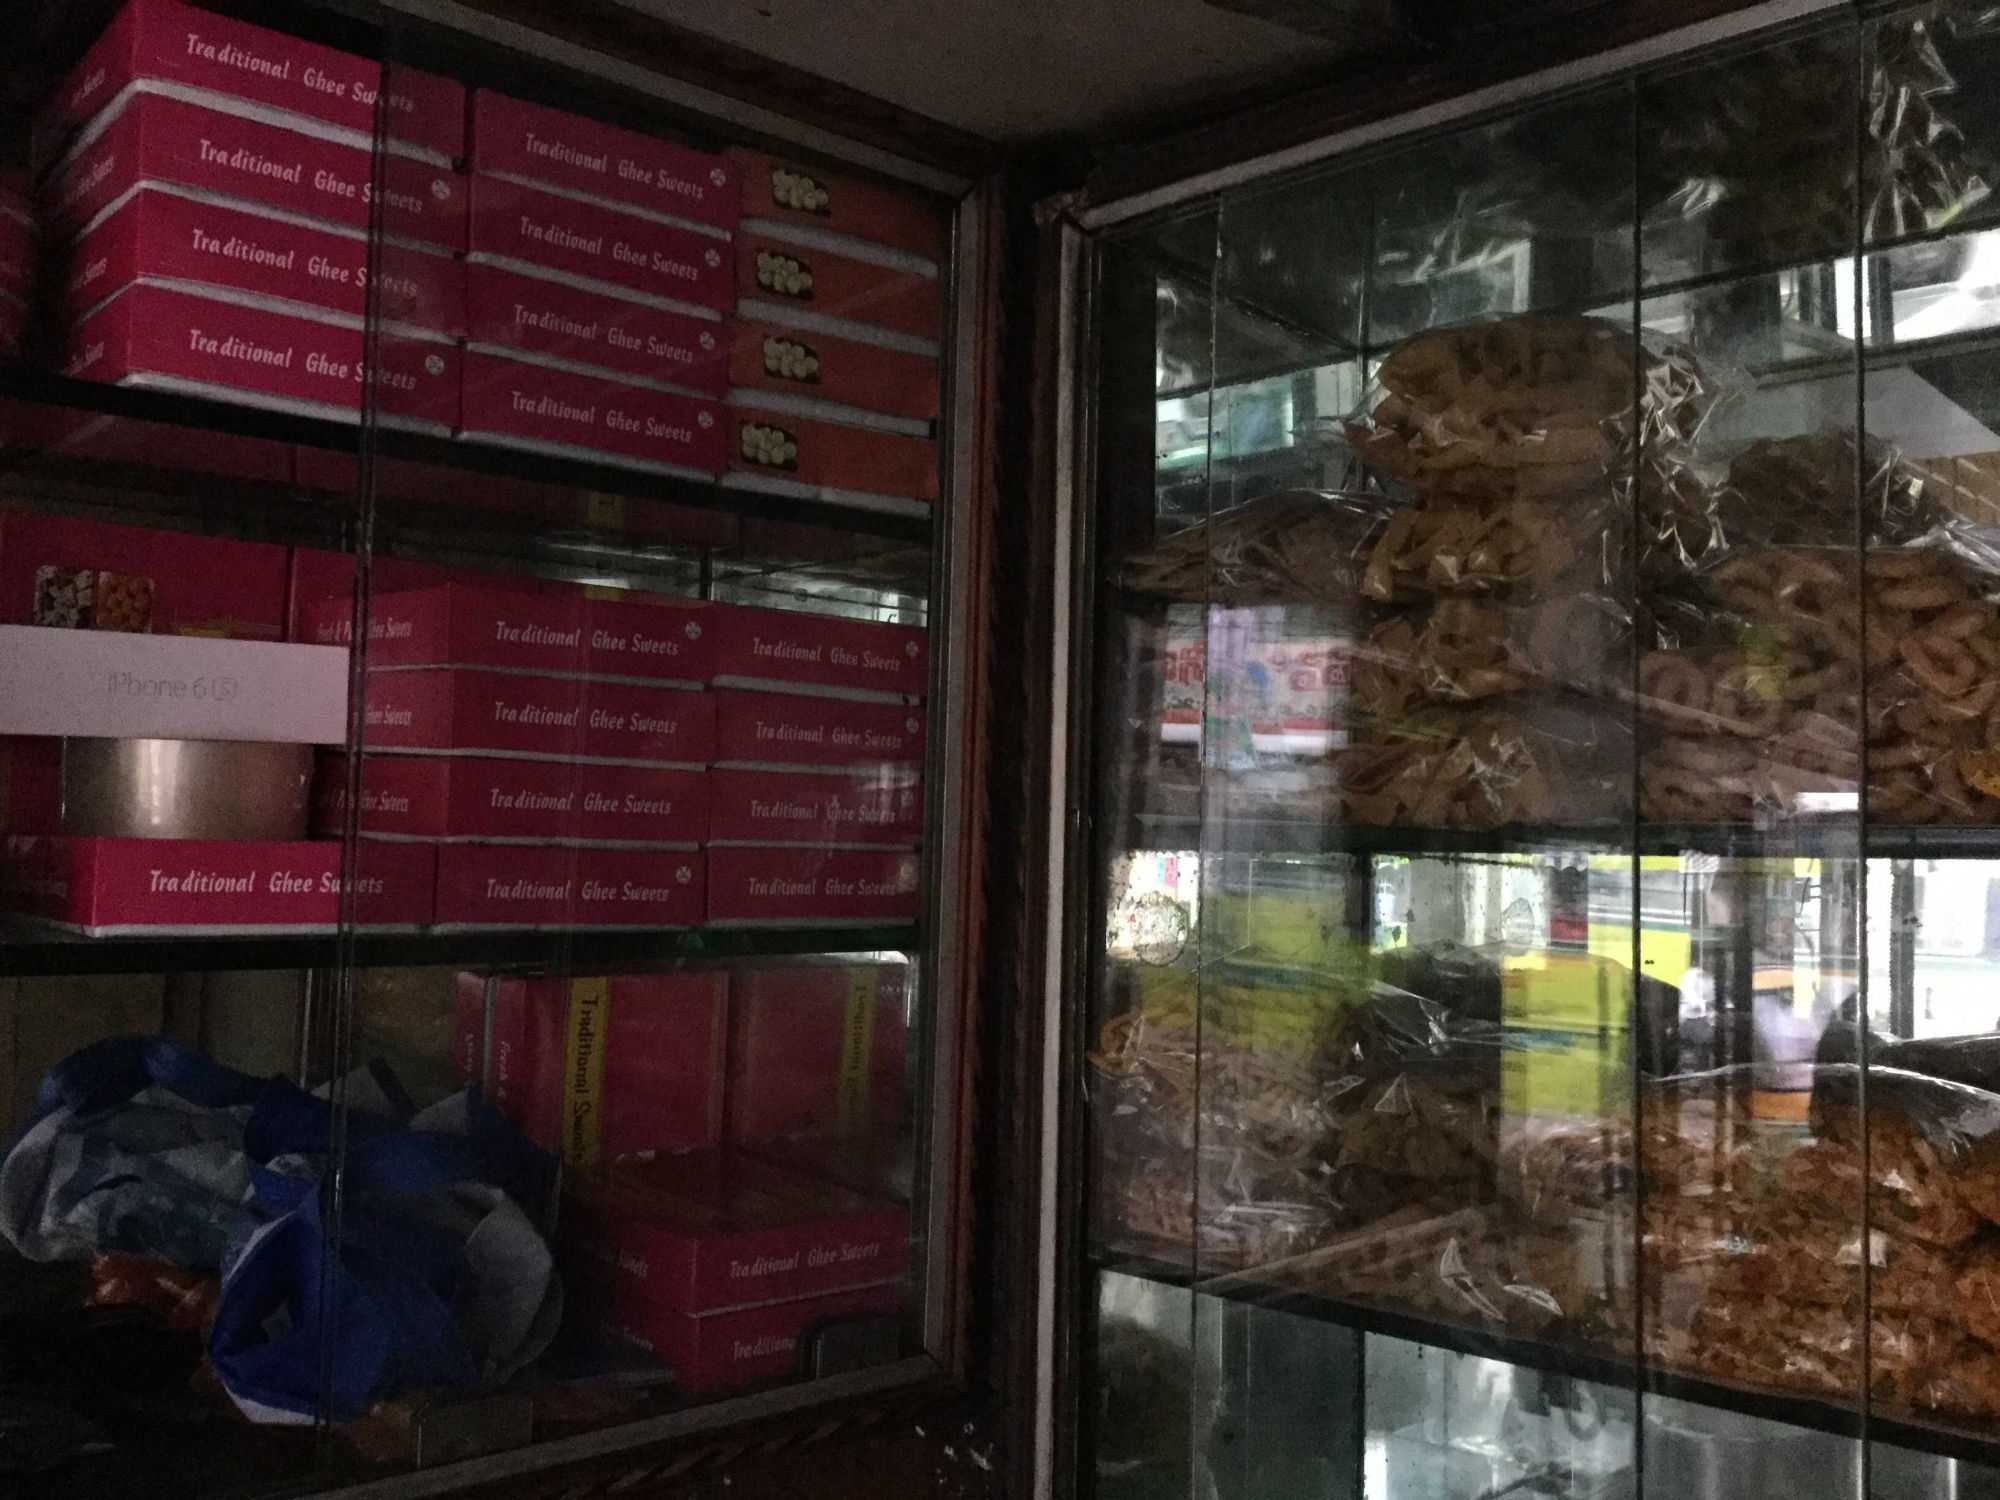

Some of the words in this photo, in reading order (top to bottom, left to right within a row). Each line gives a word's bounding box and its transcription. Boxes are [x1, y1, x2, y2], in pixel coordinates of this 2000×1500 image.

[186, 33, 290, 80] Traditional
[303, 67, 346, 98] Ghee
[200, 139, 302, 184] Traditional
[314, 169, 356, 199] Ghee
[525, 133, 608, 174] Traditional
[618, 160, 653, 184] Ghee
[657, 168, 705, 200] Sweets
[192, 229, 294, 271] Traditional
[307, 256, 349, 284] Ghee
[520, 216, 603, 257] Traditional
[612, 241, 647, 268] Ghee
[652, 253, 699, 282] Sweets
[189, 329, 292, 369] Traditional
[306, 352, 348, 381] Ghee
[513, 304, 598, 345] Traditional
[607, 327, 642, 353] Ghee
[648, 336, 694, 364] Sweets
[511, 391, 596, 427] Traditional
[606, 409, 640, 434] Ghee
[647, 416, 693, 444] Sweets
[495, 621, 580, 649] Traditional
[591, 630, 626, 652] Ghee
[632, 634, 679, 657] Sweets
[752, 637, 822, 663] Traditional
[830, 647, 858, 666] Ghee
[863, 649, 901, 673] Sweets
[494, 701, 579, 728] Traditional
[589, 708, 625, 730] Ghee
[630, 711, 677, 735] Sweets
[755, 720, 823, 744] Traditional
[831, 731, 860, 747] Ghee
[490, 788, 573, 811] Traditional
[584, 793, 619, 814] Ghee
[624, 794, 671, 816] Sweets
[150, 868, 255, 893] Traditional
[269, 872, 313, 894] Ghee
[486, 878, 571, 902] Traditional
[582, 880, 617, 902] Ghee
[623, 881, 669, 903] Sweets
[747, 875, 817, 897] Traditional
[825, 879, 854, 897] Ghee
